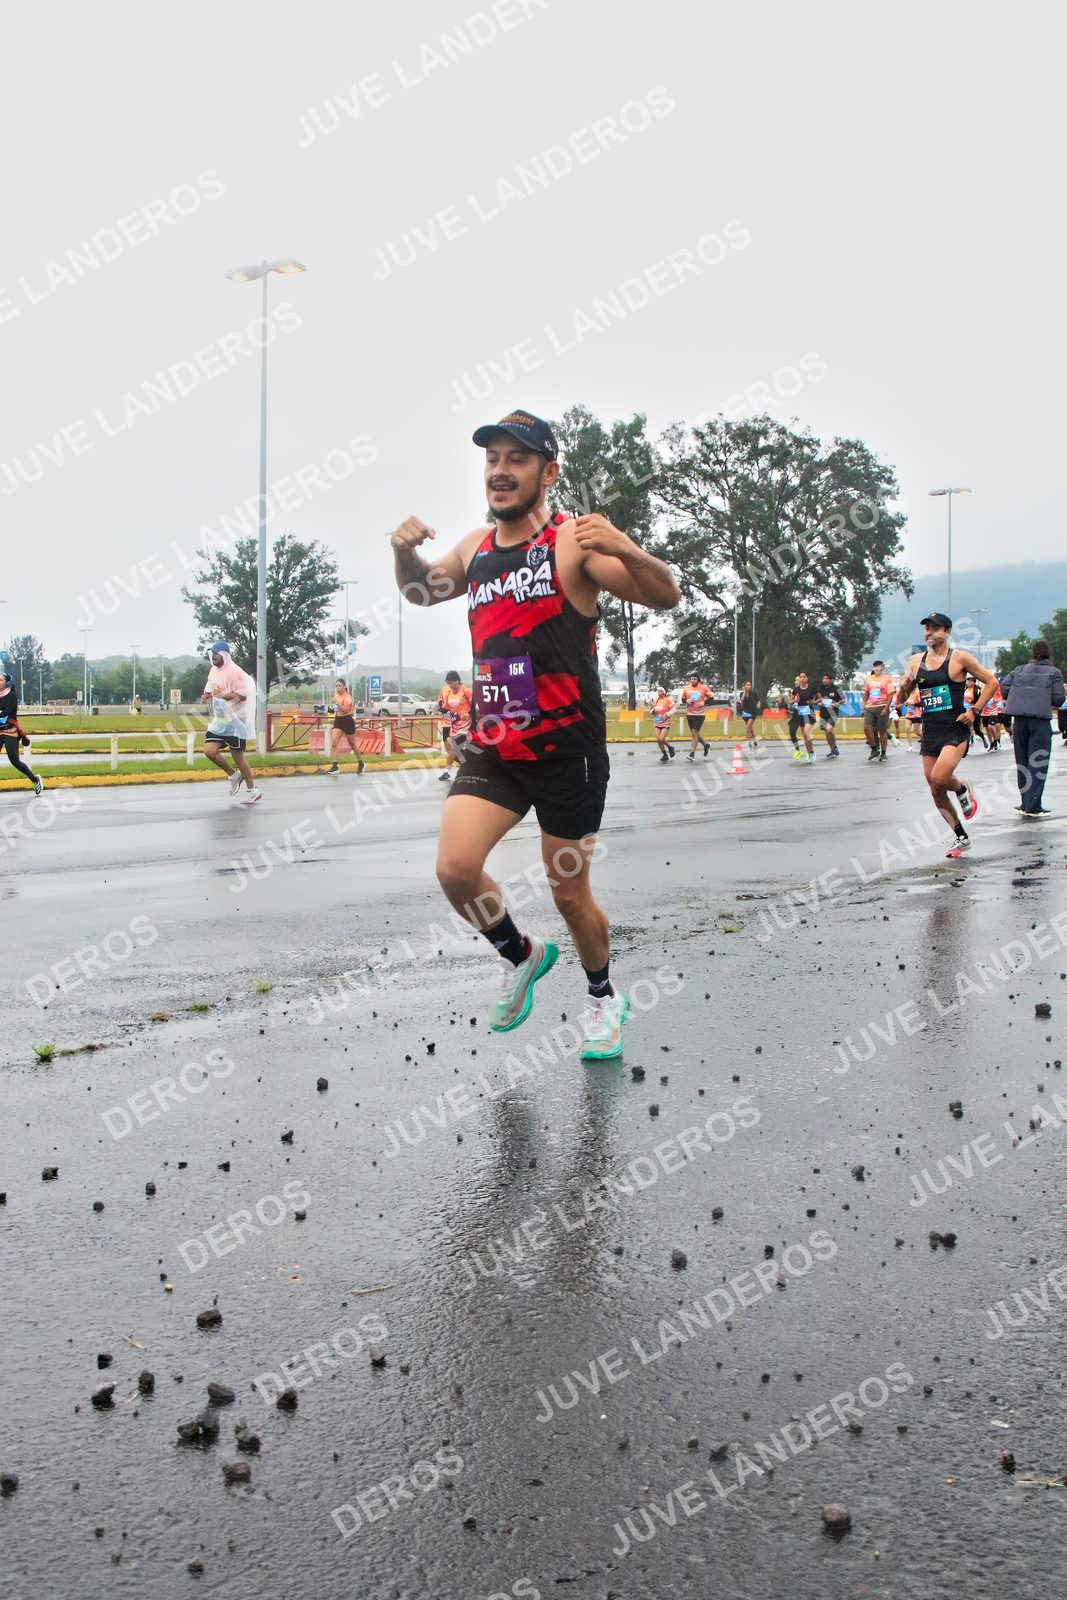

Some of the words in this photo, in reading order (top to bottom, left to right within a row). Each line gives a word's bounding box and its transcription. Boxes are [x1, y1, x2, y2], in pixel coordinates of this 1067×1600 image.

[513, 582, 556, 603] TRAIL
[482, 685, 510, 703] 571
[924, 696, 943, 706] 1238
